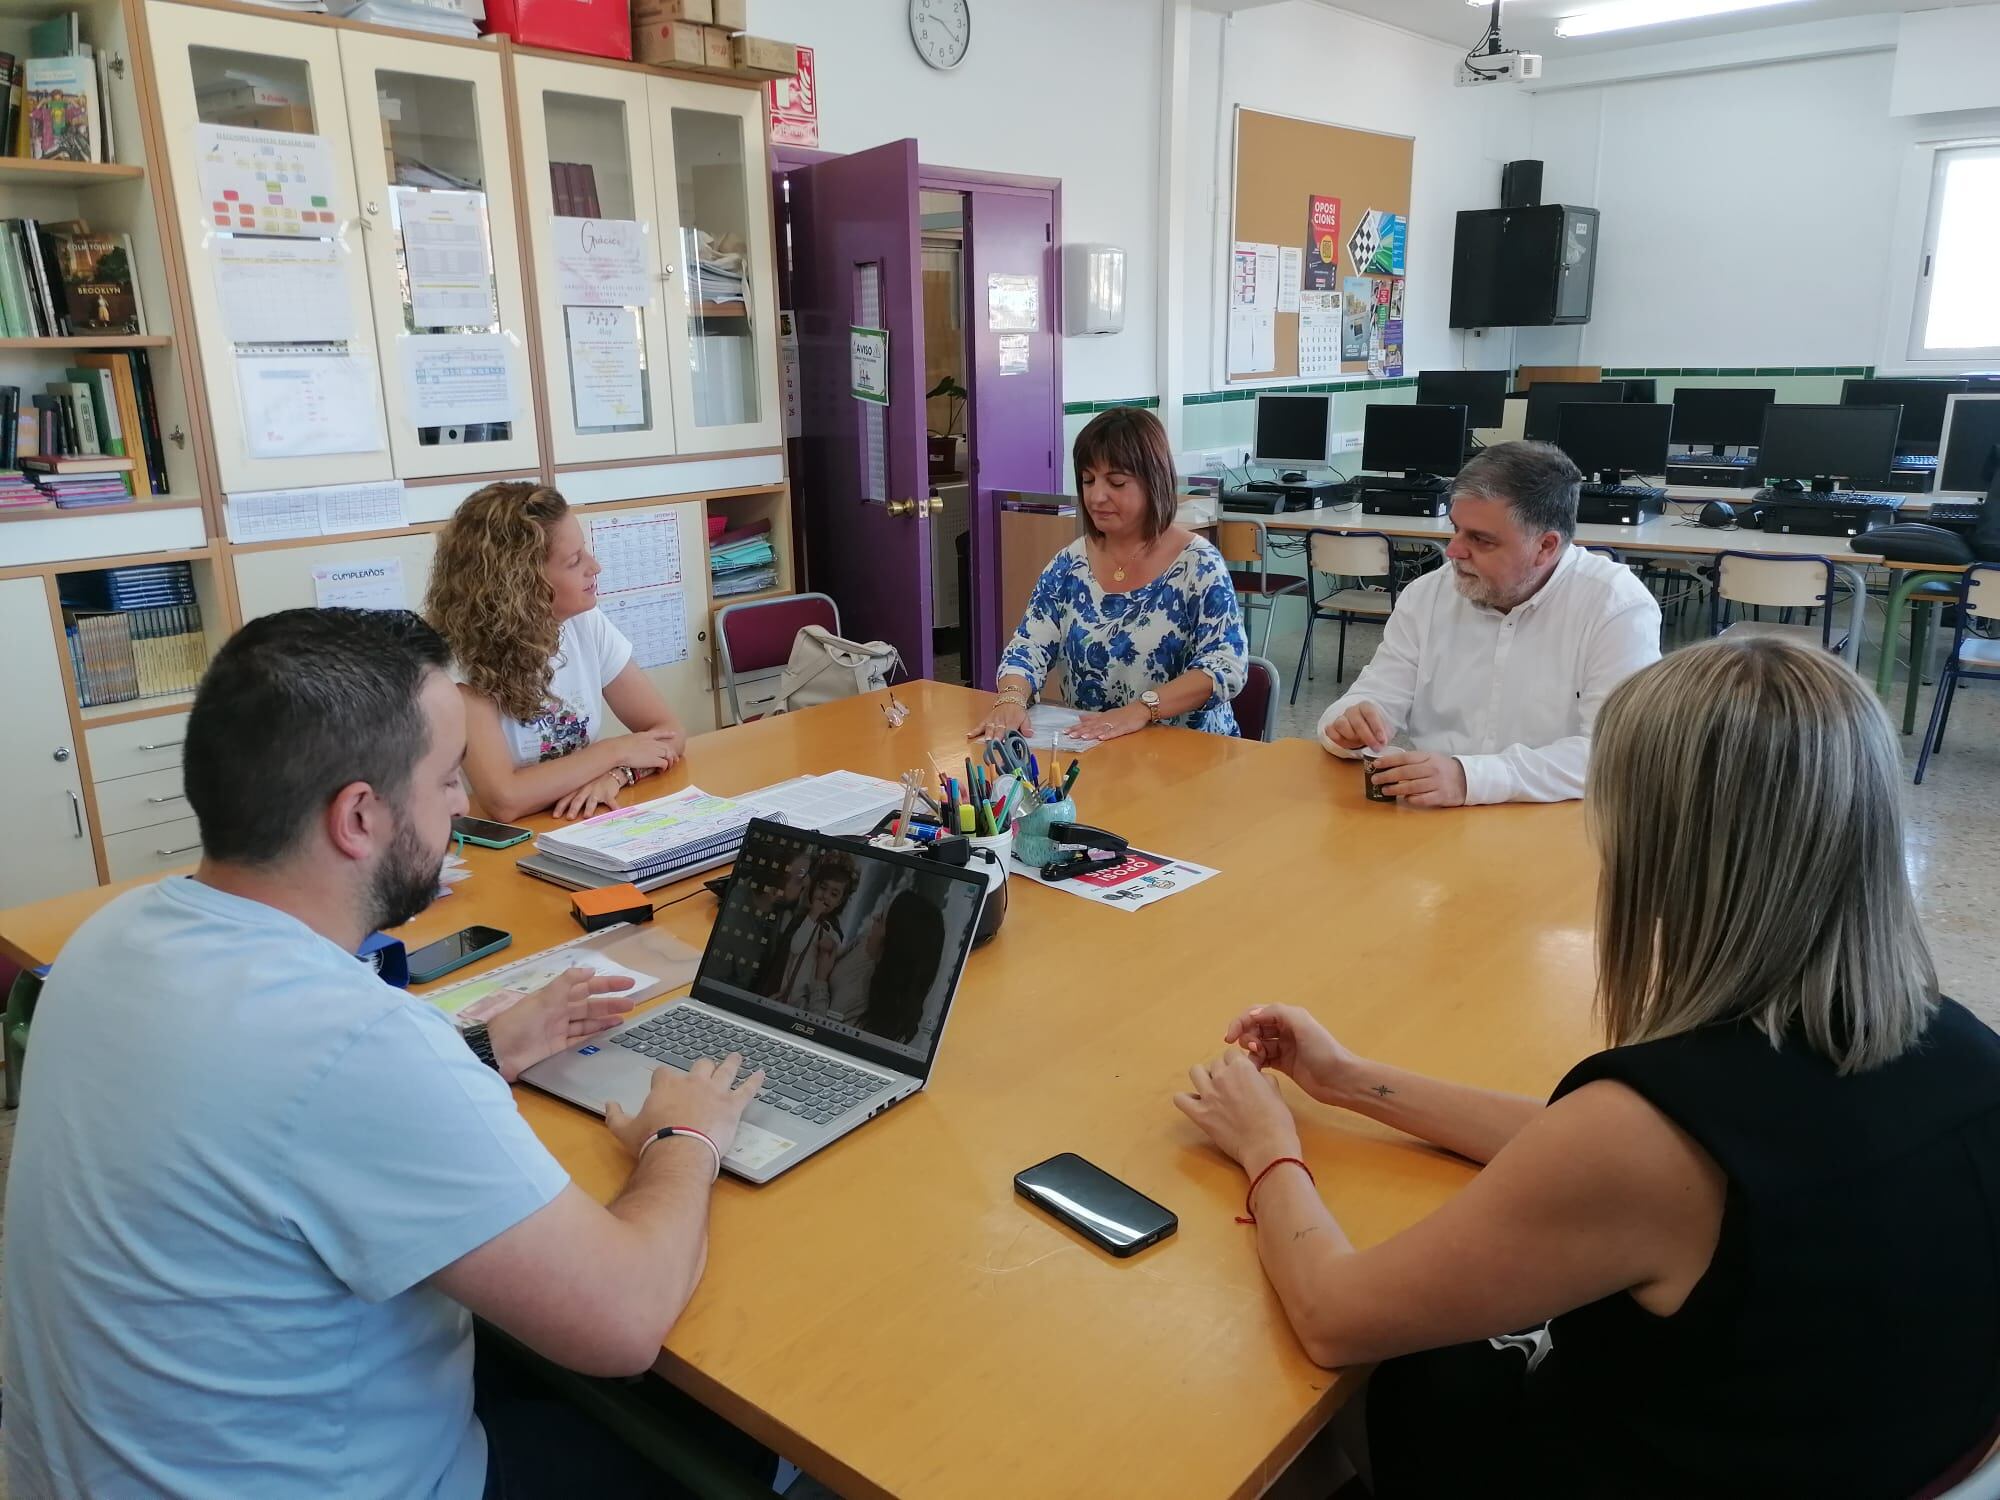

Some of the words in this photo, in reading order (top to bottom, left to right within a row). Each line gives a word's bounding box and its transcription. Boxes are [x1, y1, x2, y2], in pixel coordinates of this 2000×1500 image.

[953, 3, 959, 13] 2
[918, 13, 925, 23] 9
[956, 19, 962, 29] 3
[922, 29, 928, 40] 8
[939, 47, 945, 58] 6
[949, 44, 954, 55] 5
[1314, 201, 1336, 214] OPOSI
[1314, 213, 1336, 226] CIONS
[77, 286, 121, 296] BROOKLYN
[857, 344, 872, 355] AVISO
[331, 567, 385, 581] CUMPLEAÑOS
[1097, 861, 1149, 882] OPOSI
[791, 1022, 816, 1036] ASUS
